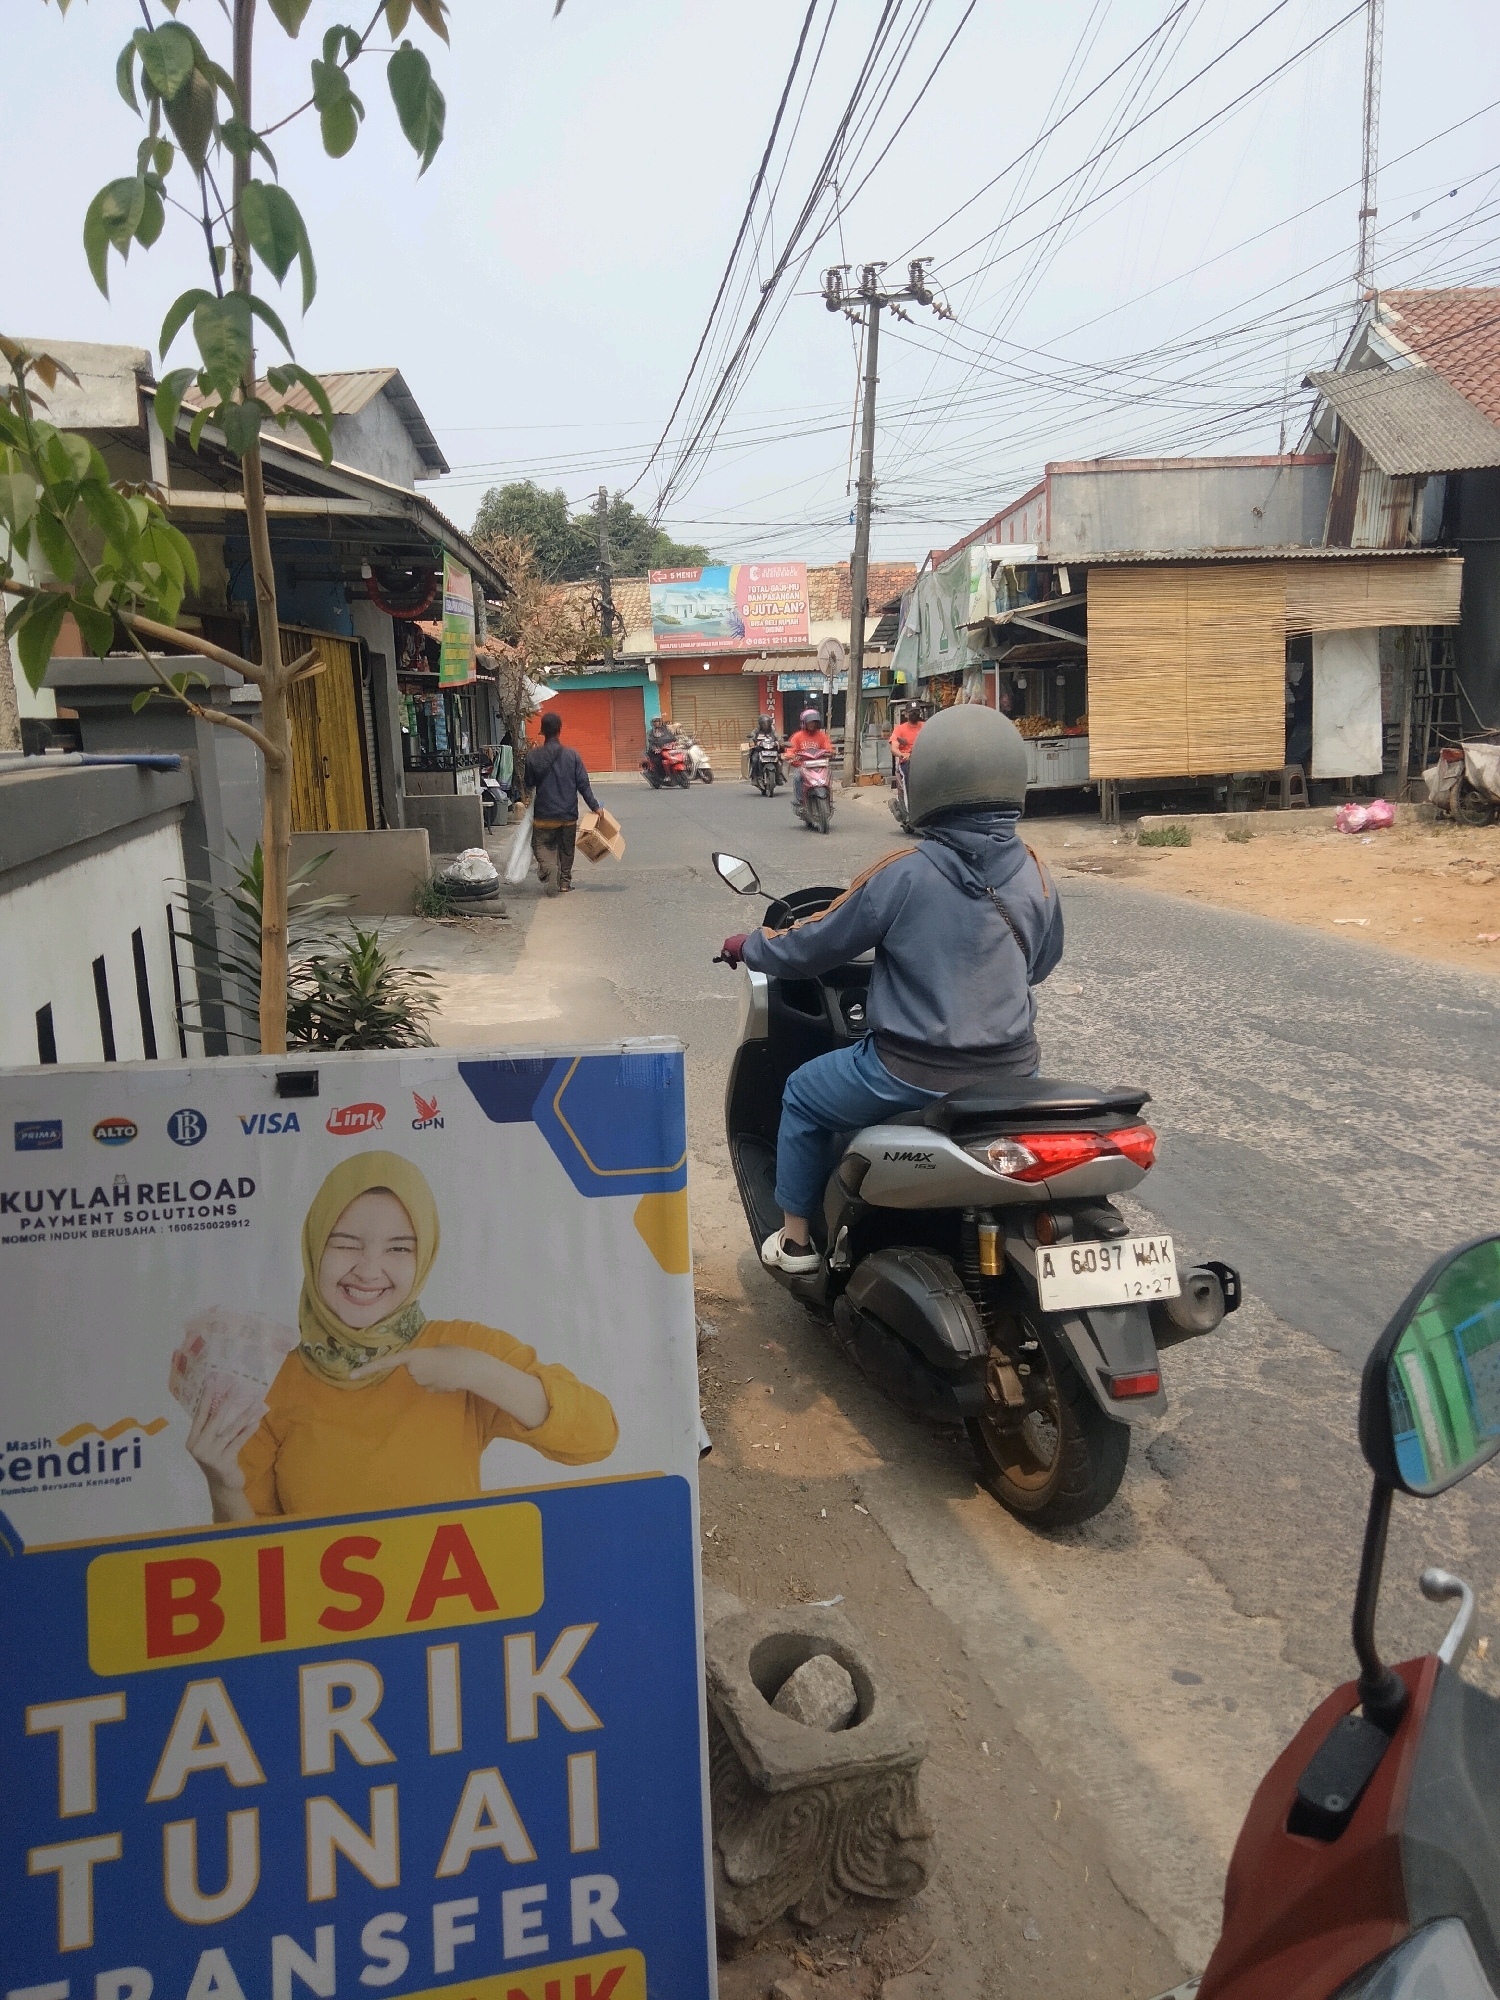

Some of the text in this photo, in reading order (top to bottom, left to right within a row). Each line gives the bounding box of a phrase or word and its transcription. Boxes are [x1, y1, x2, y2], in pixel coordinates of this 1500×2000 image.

[676, 571, 698, 579] MENIT
[747, 592, 800, 602] DAN PASANGAN
[748, 584, 800, 593] TOTAL GAJI-MU
[742, 602, 806, 616] 8 JUTA-AN?
[766, 674, 775, 710] TERIMA
[236, 1112, 301, 1136] VISA
[329, 1107, 384, 1130] Link
[411, 1117, 444, 1131] GPN
[21, 1130, 57, 1140] PRIMA
[96, 1126, 136, 1138] ALTO
[883, 1151, 935, 1163] NMAX
[0, 1177, 256, 1214] KUYLAH RELOAD
[20, 1203, 237, 1230] PAYMENT SOLUTIONS
[1, 1233, 46, 1245] NOMOR
[50, 1230, 88, 1241] INDUK
[92, 1225, 156, 1238] BERUSAHA
[1043, 1239, 1172, 1279] A 6097 WAK
[6, 1437, 52, 1452] Masih
[42, 1481, 83, 1492] Bersama
[86, 1476, 132, 1486] Kenangan
[145, 1523, 500, 1660] BISA
[25, 1622, 604, 1819] TARIK
[27, 1750, 600, 1954] TUNAI
